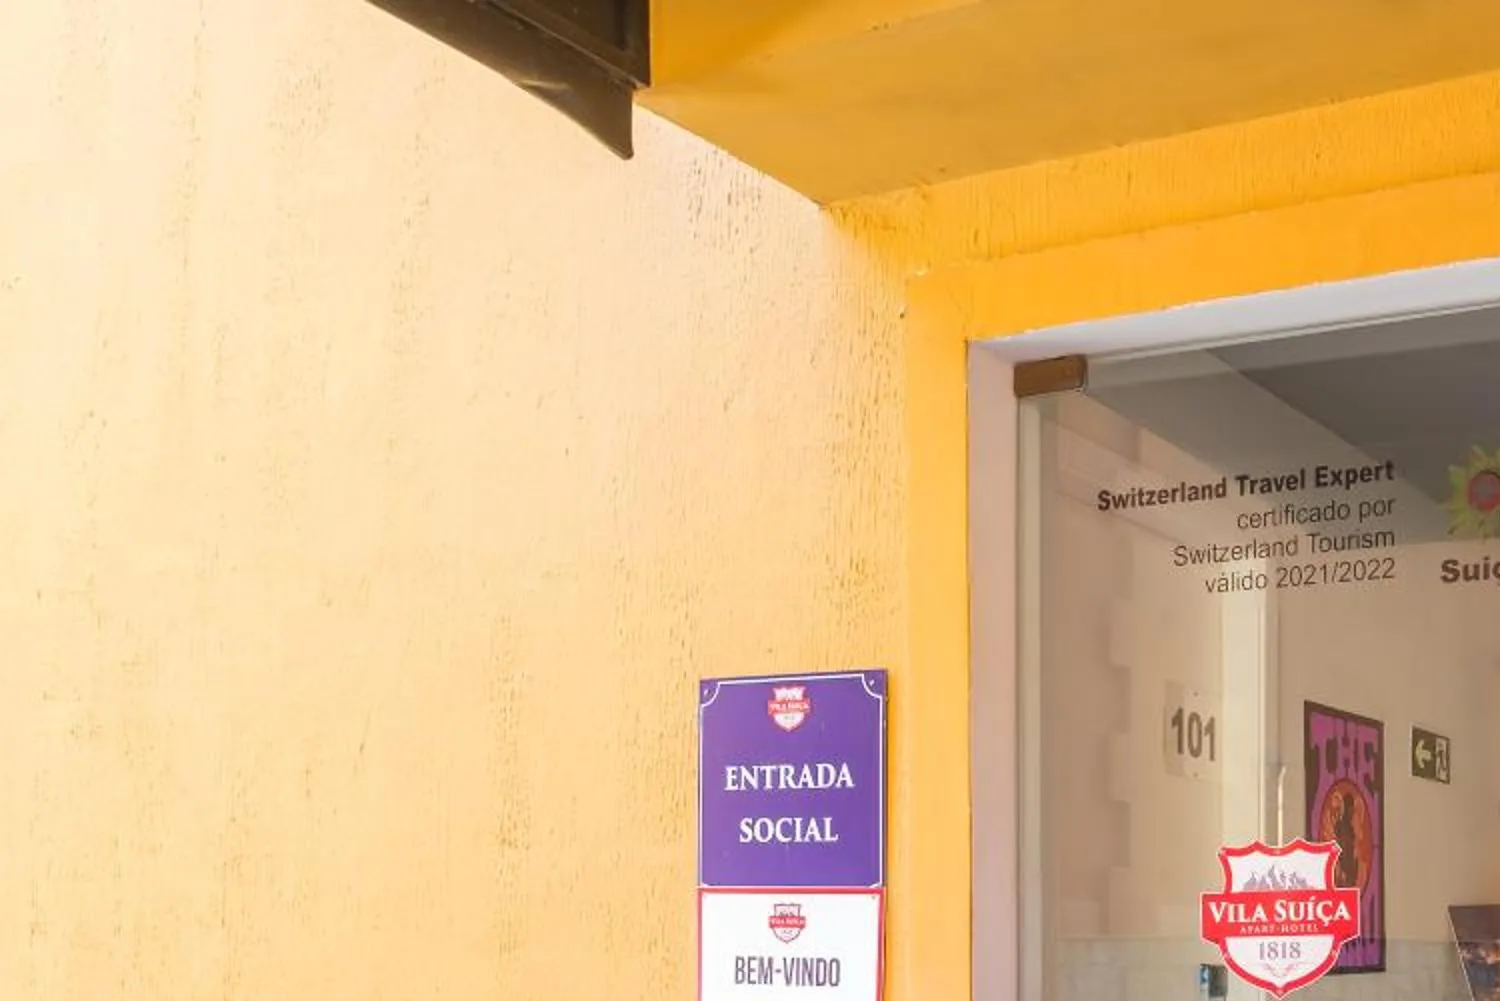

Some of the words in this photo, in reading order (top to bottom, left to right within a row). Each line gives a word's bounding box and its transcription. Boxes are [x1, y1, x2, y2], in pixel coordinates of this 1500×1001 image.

[1097, 477, 1227, 511] Switzerland
[1236, 468, 1306, 498] Travel
[1314, 460, 1395, 491] Expert
[1237, 501, 1351, 529] certificado
[1359, 499, 1396, 521] por
[1173, 538, 1298, 567] Switzerland
[1307, 530, 1396, 554] Tourism
[1205, 570, 1268, 593] válido
[1275, 557, 1396, 590] 2021/2022
[1171, 706, 1216, 762] 101
[724, 762, 855, 791] ENTRADA
[739, 817, 839, 843] SOCIAL
[1208, 901, 1268, 924] VILA
[1274, 896, 1351, 927] SUÍÇA
[1257, 940, 1301, 961] 1818
[734, 956, 841, 987] BEM-VINDO
